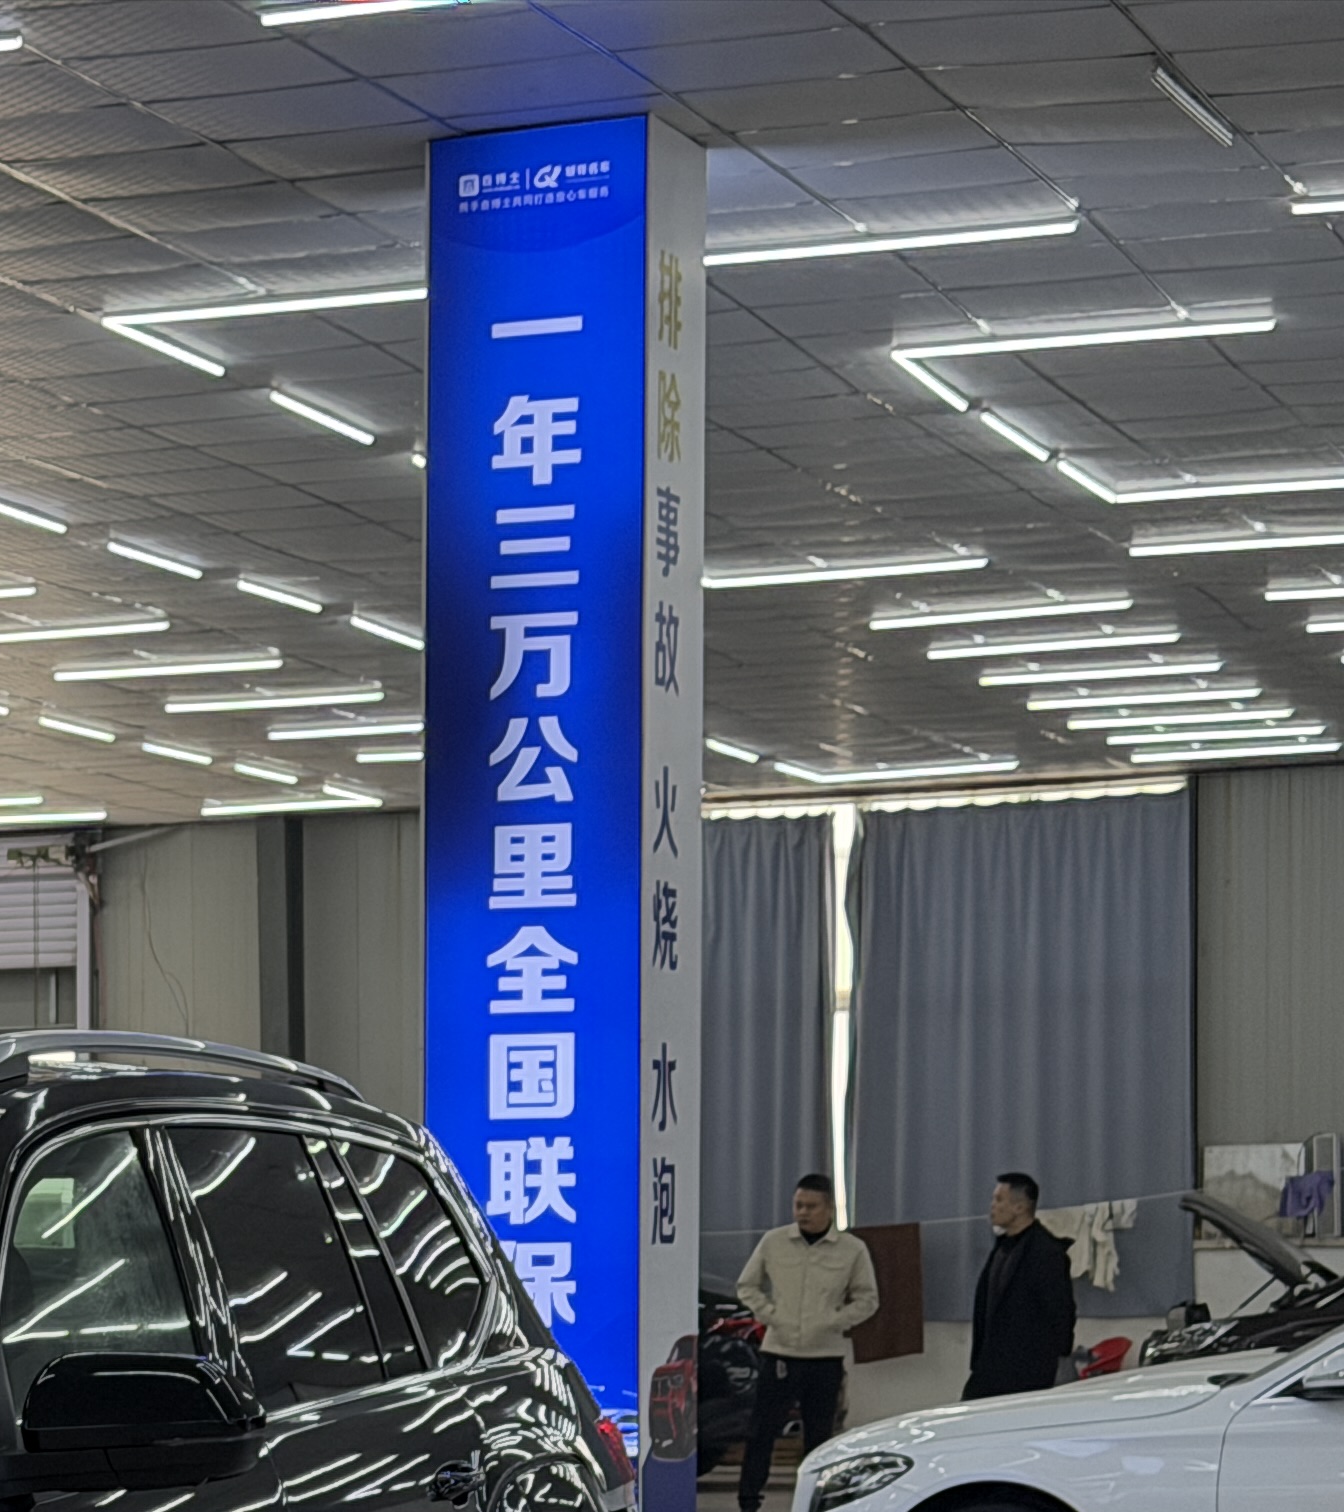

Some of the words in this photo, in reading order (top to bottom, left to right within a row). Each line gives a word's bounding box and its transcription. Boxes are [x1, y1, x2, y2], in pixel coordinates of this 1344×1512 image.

[654, 249, 683, 697] 排除事故
[487, 314, 584, 1329] 一年三万公里全国联保
[651, 766, 678, 972] 火烧
[651, 1042, 678, 1246] 水泡
